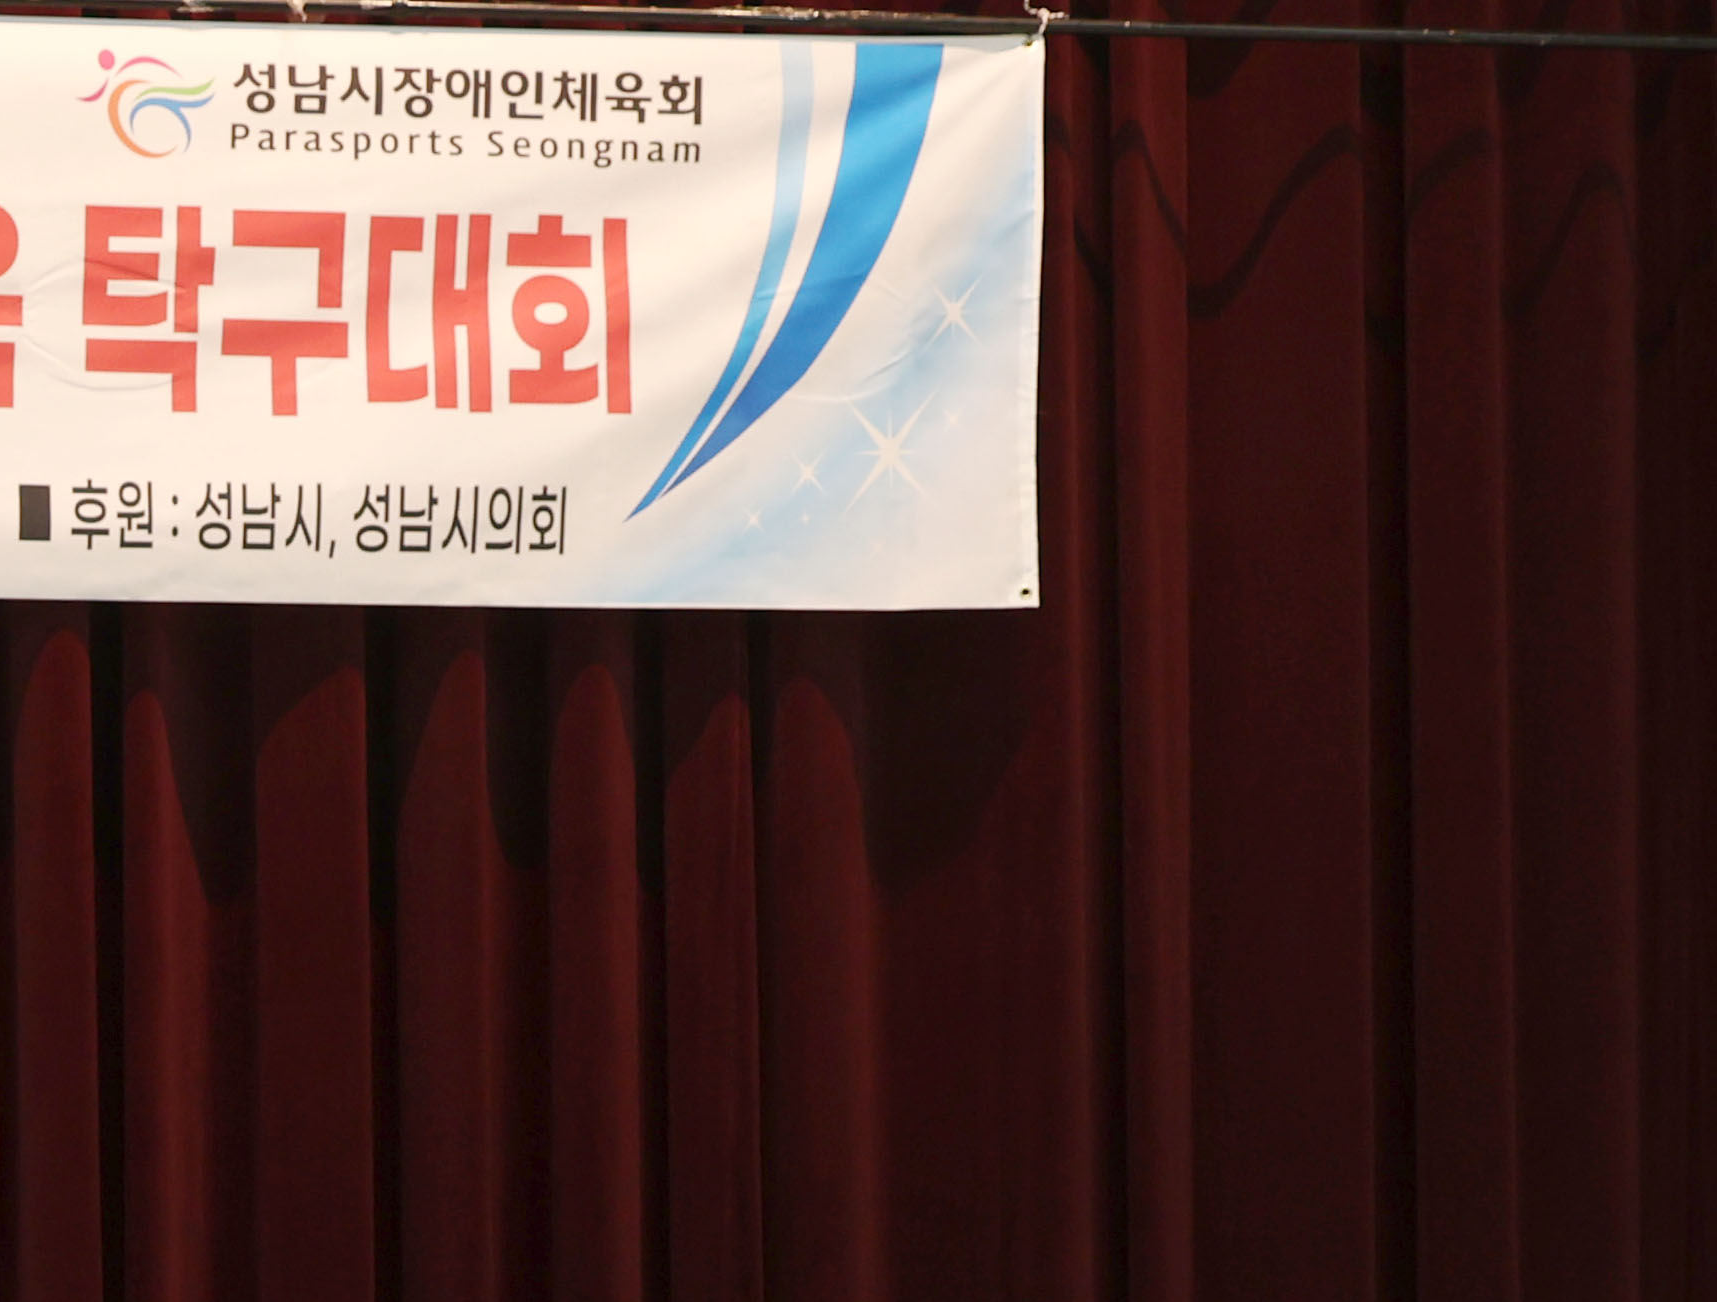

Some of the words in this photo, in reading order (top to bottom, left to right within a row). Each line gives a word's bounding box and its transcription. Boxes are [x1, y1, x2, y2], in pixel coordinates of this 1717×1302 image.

[232, 64, 702, 128] 성남시장애인체육회
[231, 124, 462, 160] Parasports
[488, 131, 700, 168] Seongnam
[82, 205, 631, 416] 탁구대회
[196, 483, 335, 558] 성남시,
[354, 485, 566, 554] 성남시의회
